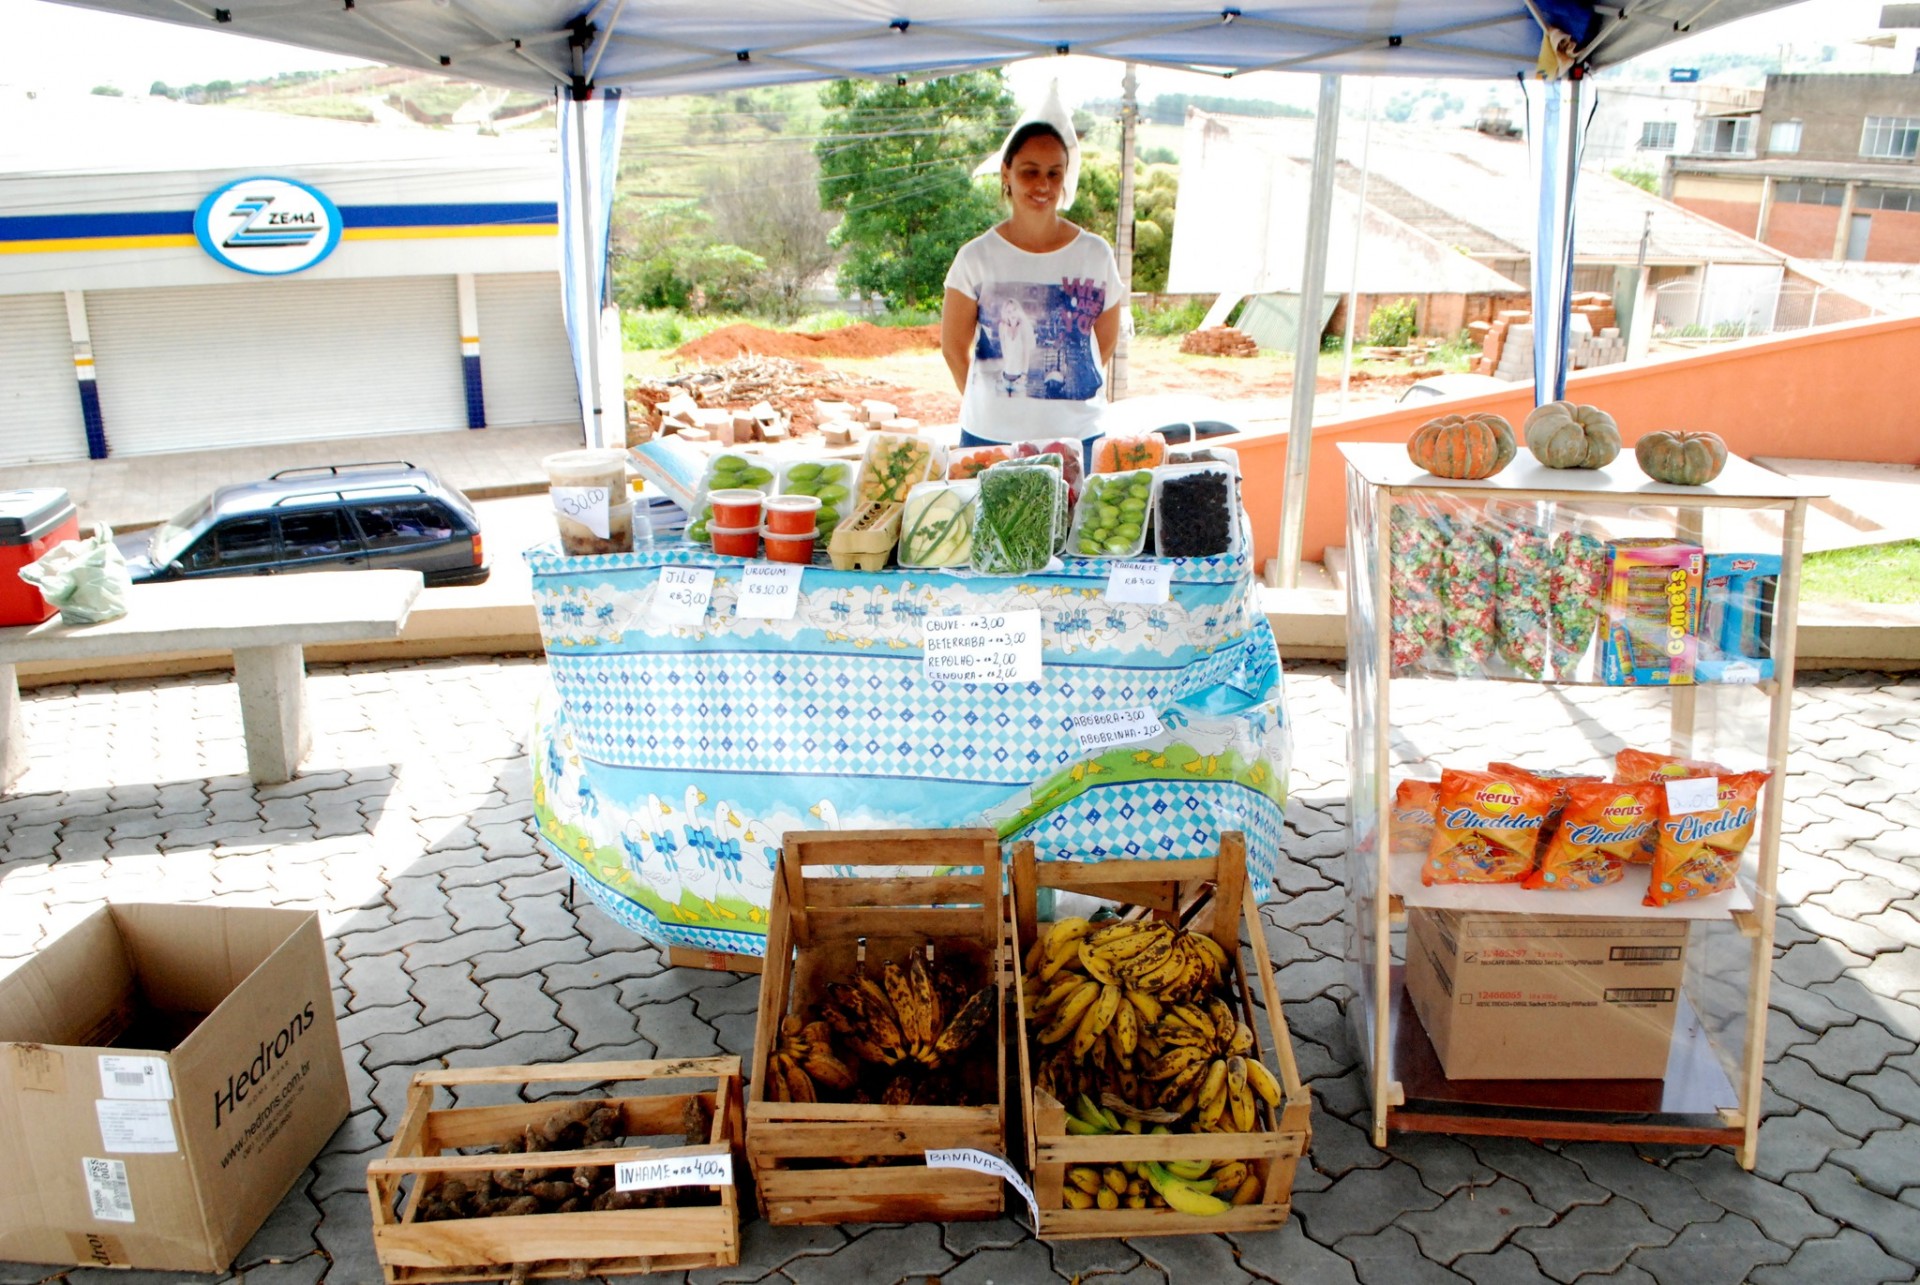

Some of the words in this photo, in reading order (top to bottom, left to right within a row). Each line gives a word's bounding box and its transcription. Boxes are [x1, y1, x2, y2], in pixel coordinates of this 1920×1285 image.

[268, 211, 316, 225] ZEMA
[1442, 807, 1543, 830] Cheddar
[214, 1000, 316, 1130] Hedrons
[220, 1059, 312, 1170] www.hedrons.com.br
